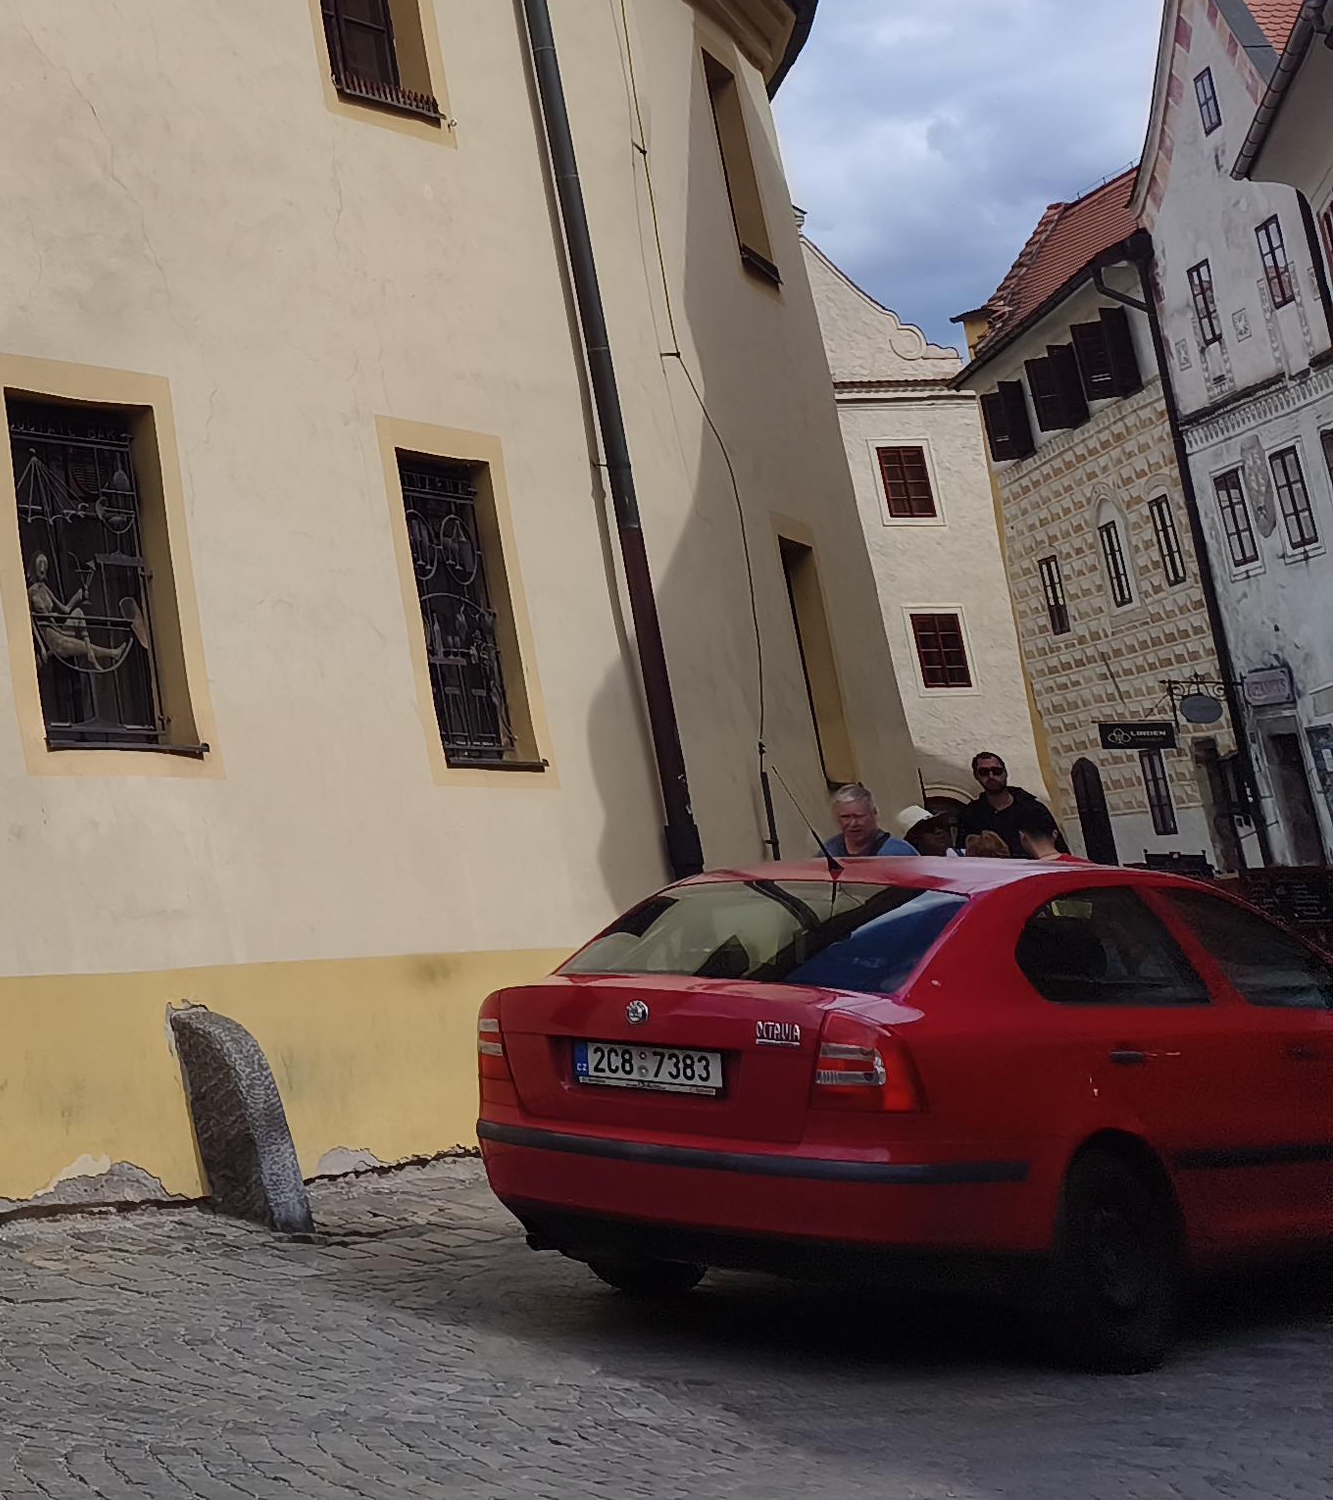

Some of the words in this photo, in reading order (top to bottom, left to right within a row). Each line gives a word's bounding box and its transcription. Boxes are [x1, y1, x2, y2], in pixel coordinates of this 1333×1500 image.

[576, 1062, 588, 1072] CZ
[593, 1046, 634, 1075] 2C8
[652, 1050, 711, 1082] 7383
